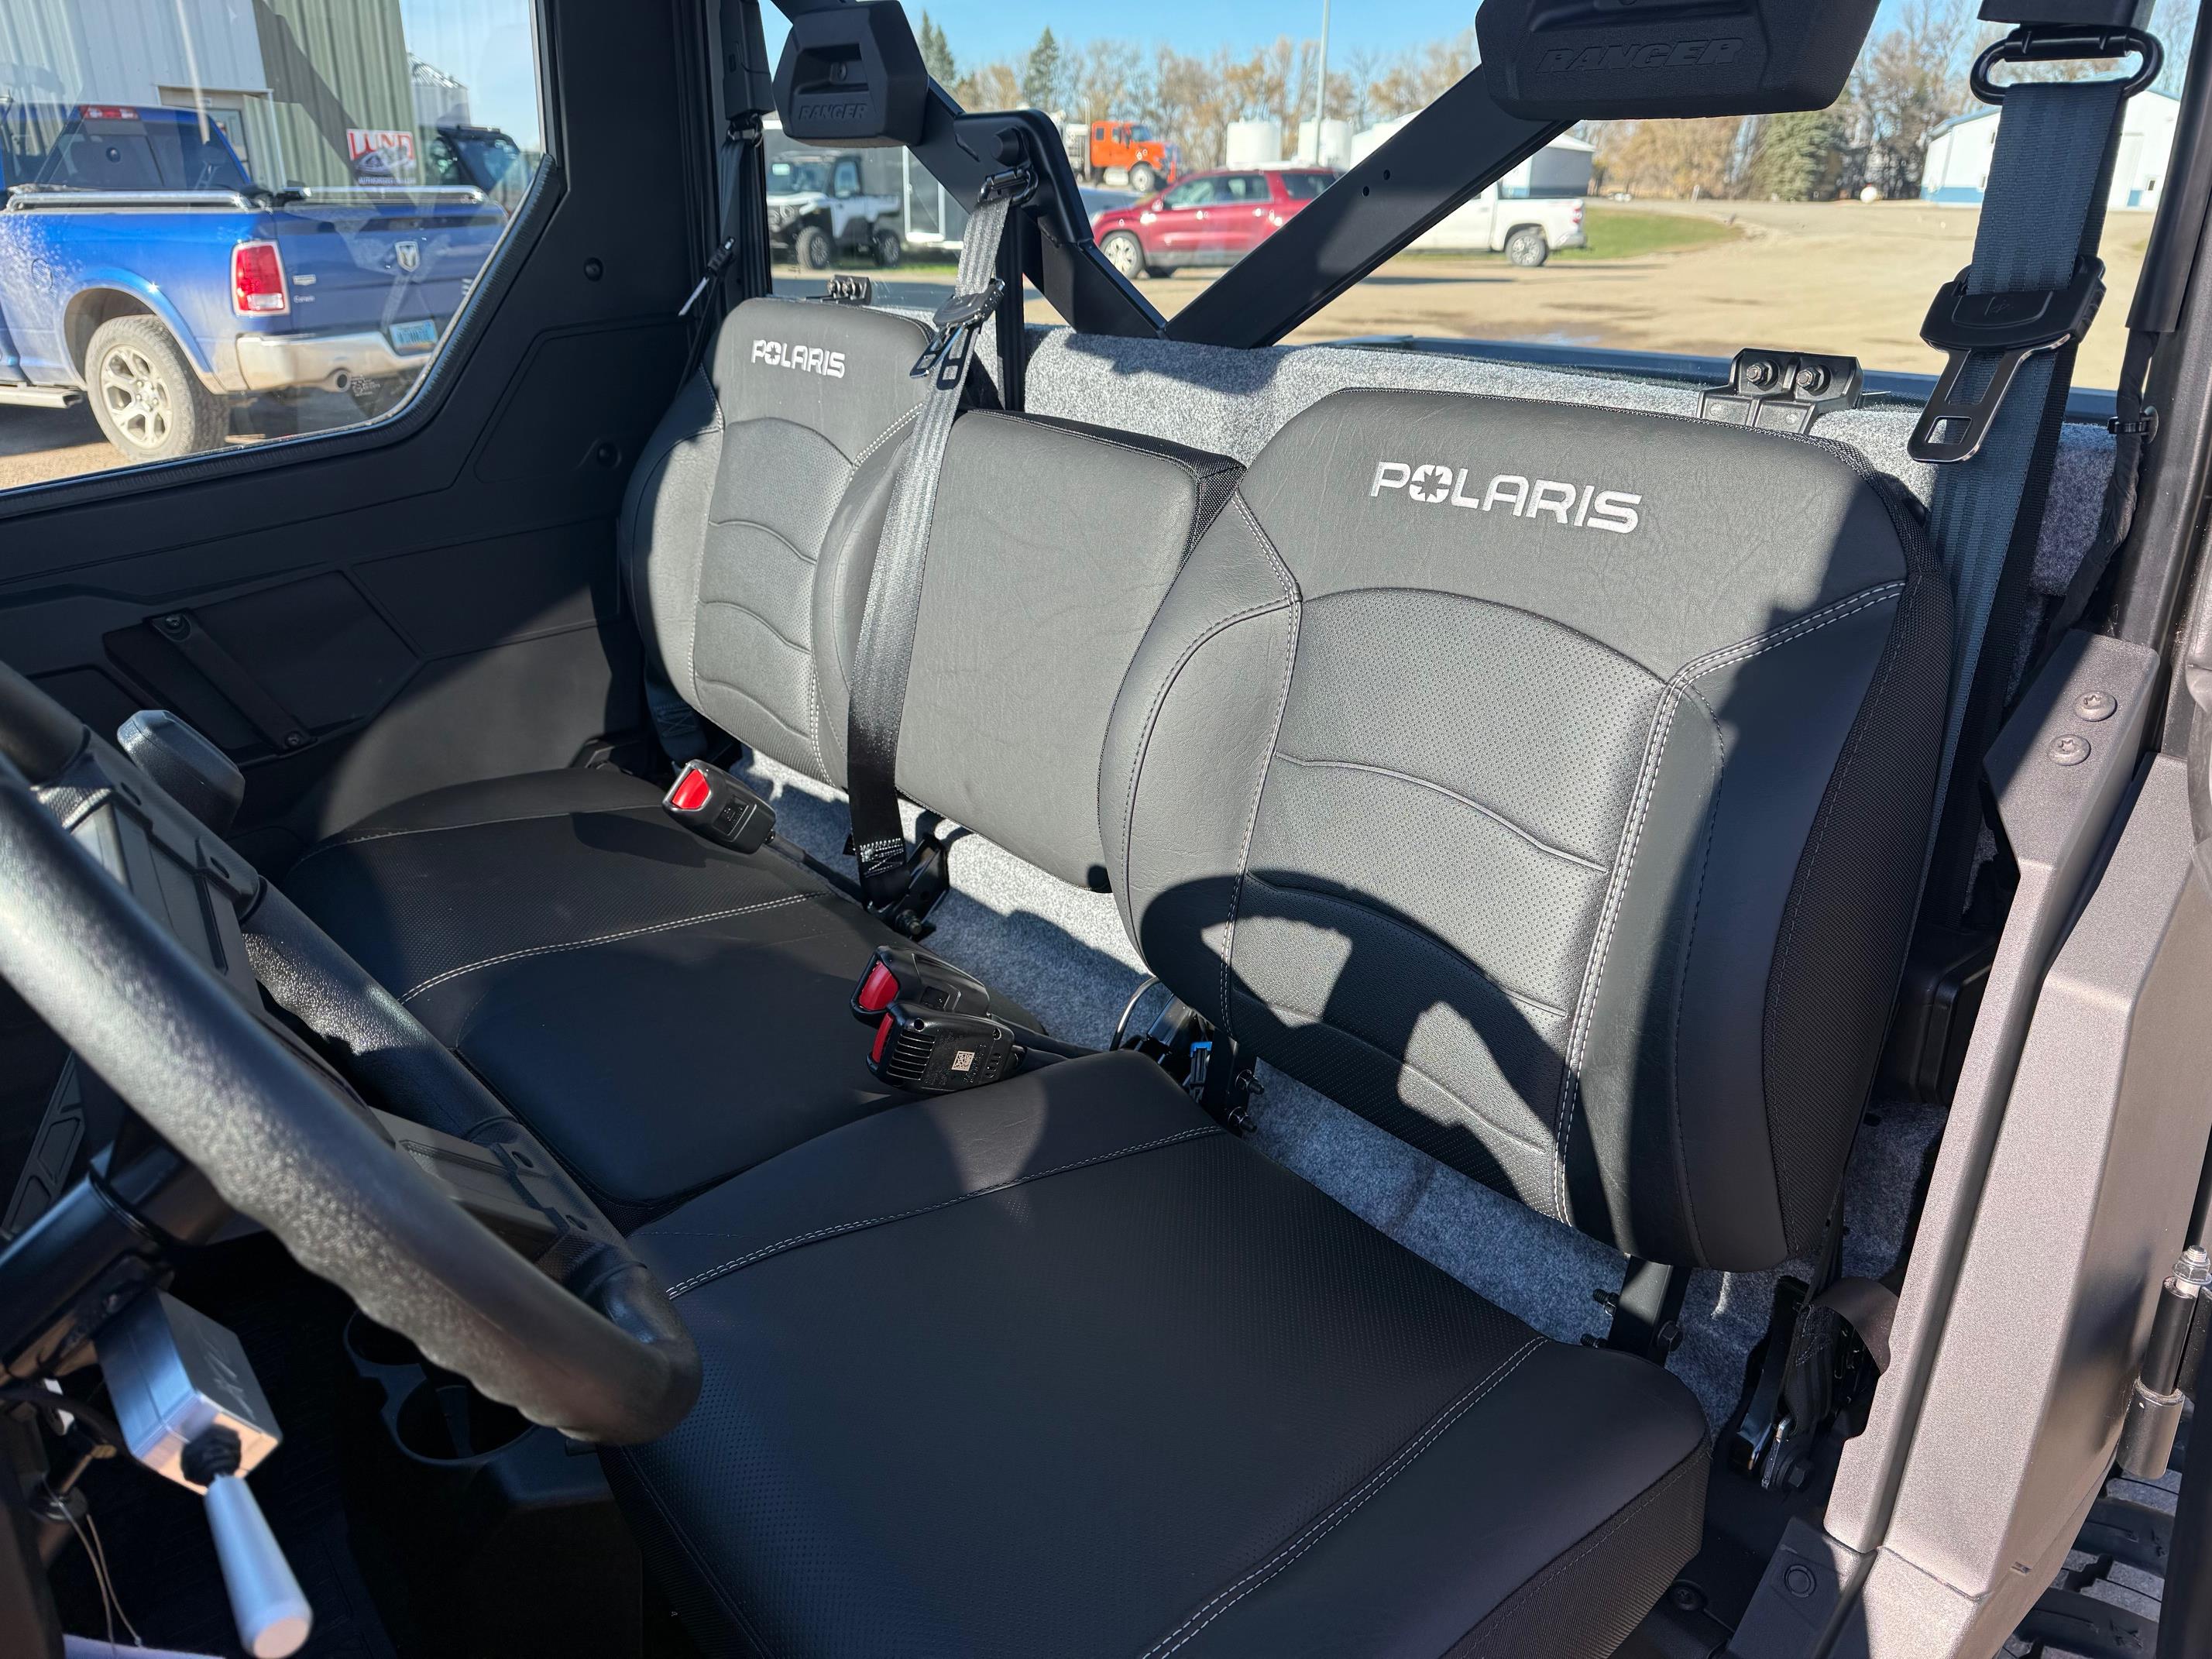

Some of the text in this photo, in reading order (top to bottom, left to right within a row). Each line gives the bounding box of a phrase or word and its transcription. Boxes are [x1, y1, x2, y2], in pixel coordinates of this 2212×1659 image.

[1536, 37, 1743, 74] RANGER
[799, 102, 867, 120] RANGER
[751, 339, 845, 378] POLARIS
[1370, 461, 1643, 534] POLARIS
